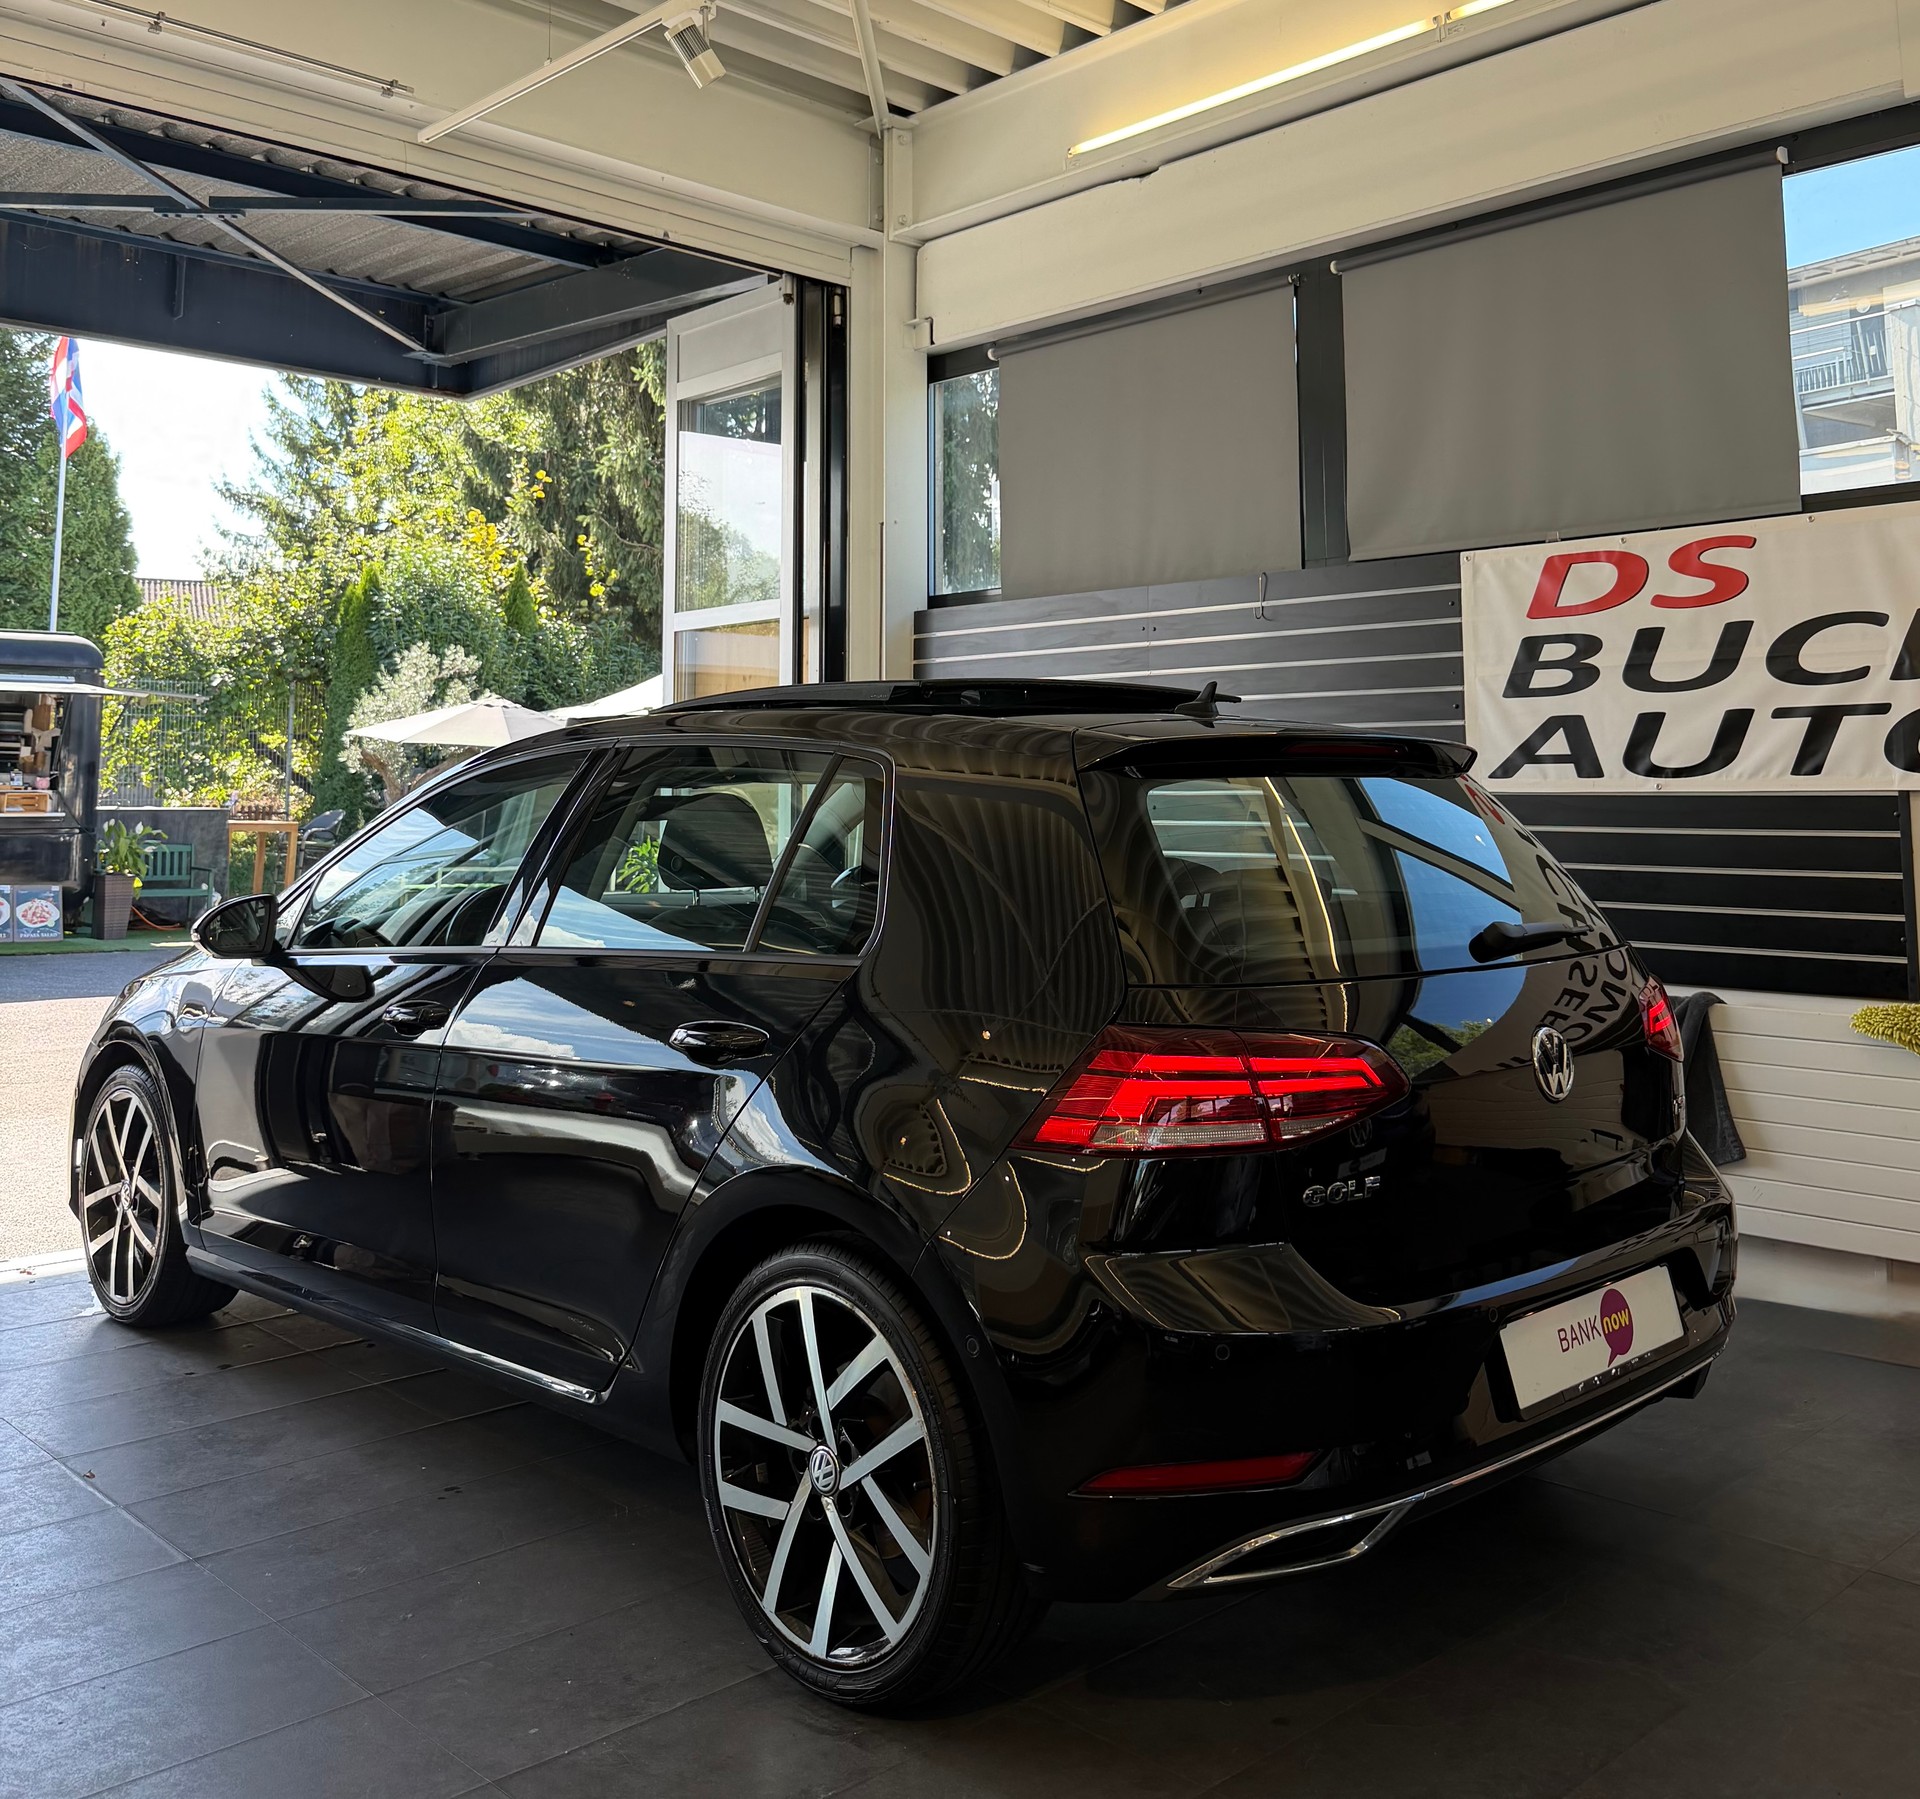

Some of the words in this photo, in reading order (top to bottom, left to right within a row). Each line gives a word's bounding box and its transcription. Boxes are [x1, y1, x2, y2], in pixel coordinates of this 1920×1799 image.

[1526, 535, 1757, 619] DS
[1302, 1176, 1381, 1207] GOLF
[1557, 1315, 1601, 1353] BANK
[1603, 1308, 1629, 1334] now
